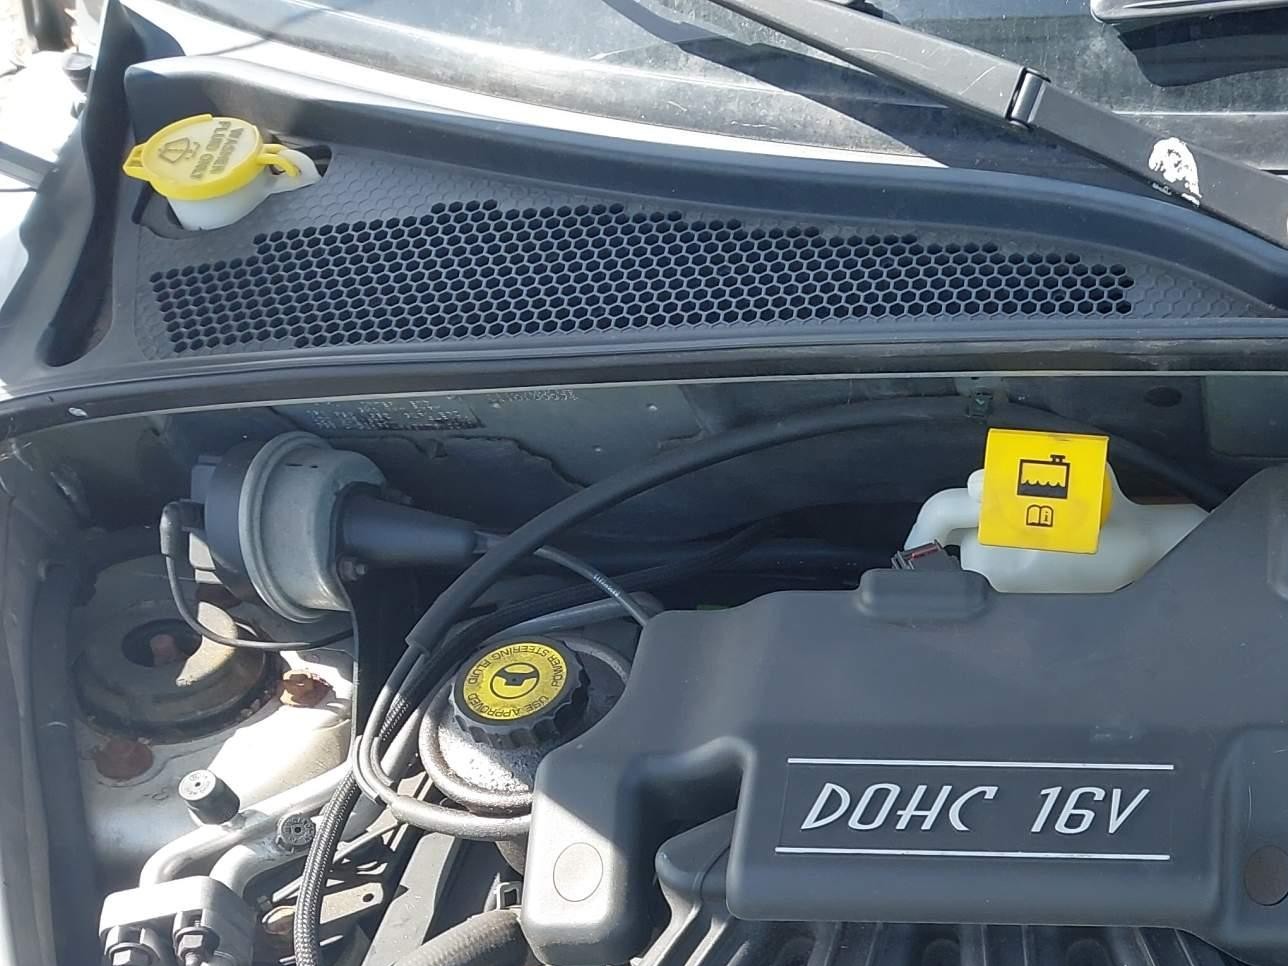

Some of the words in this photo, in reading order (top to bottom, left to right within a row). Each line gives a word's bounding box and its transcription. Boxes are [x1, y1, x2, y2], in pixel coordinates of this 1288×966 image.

[492, 645, 550, 660] STEERING
[468, 660, 492, 685] FLUID
[547, 654, 564, 688] POWER
[468, 692, 521, 718] APPROVED
[526, 695, 550, 713] USE
[800, 782, 999, 832] DOHC
[1031, 786, 1150, 835] 16V
